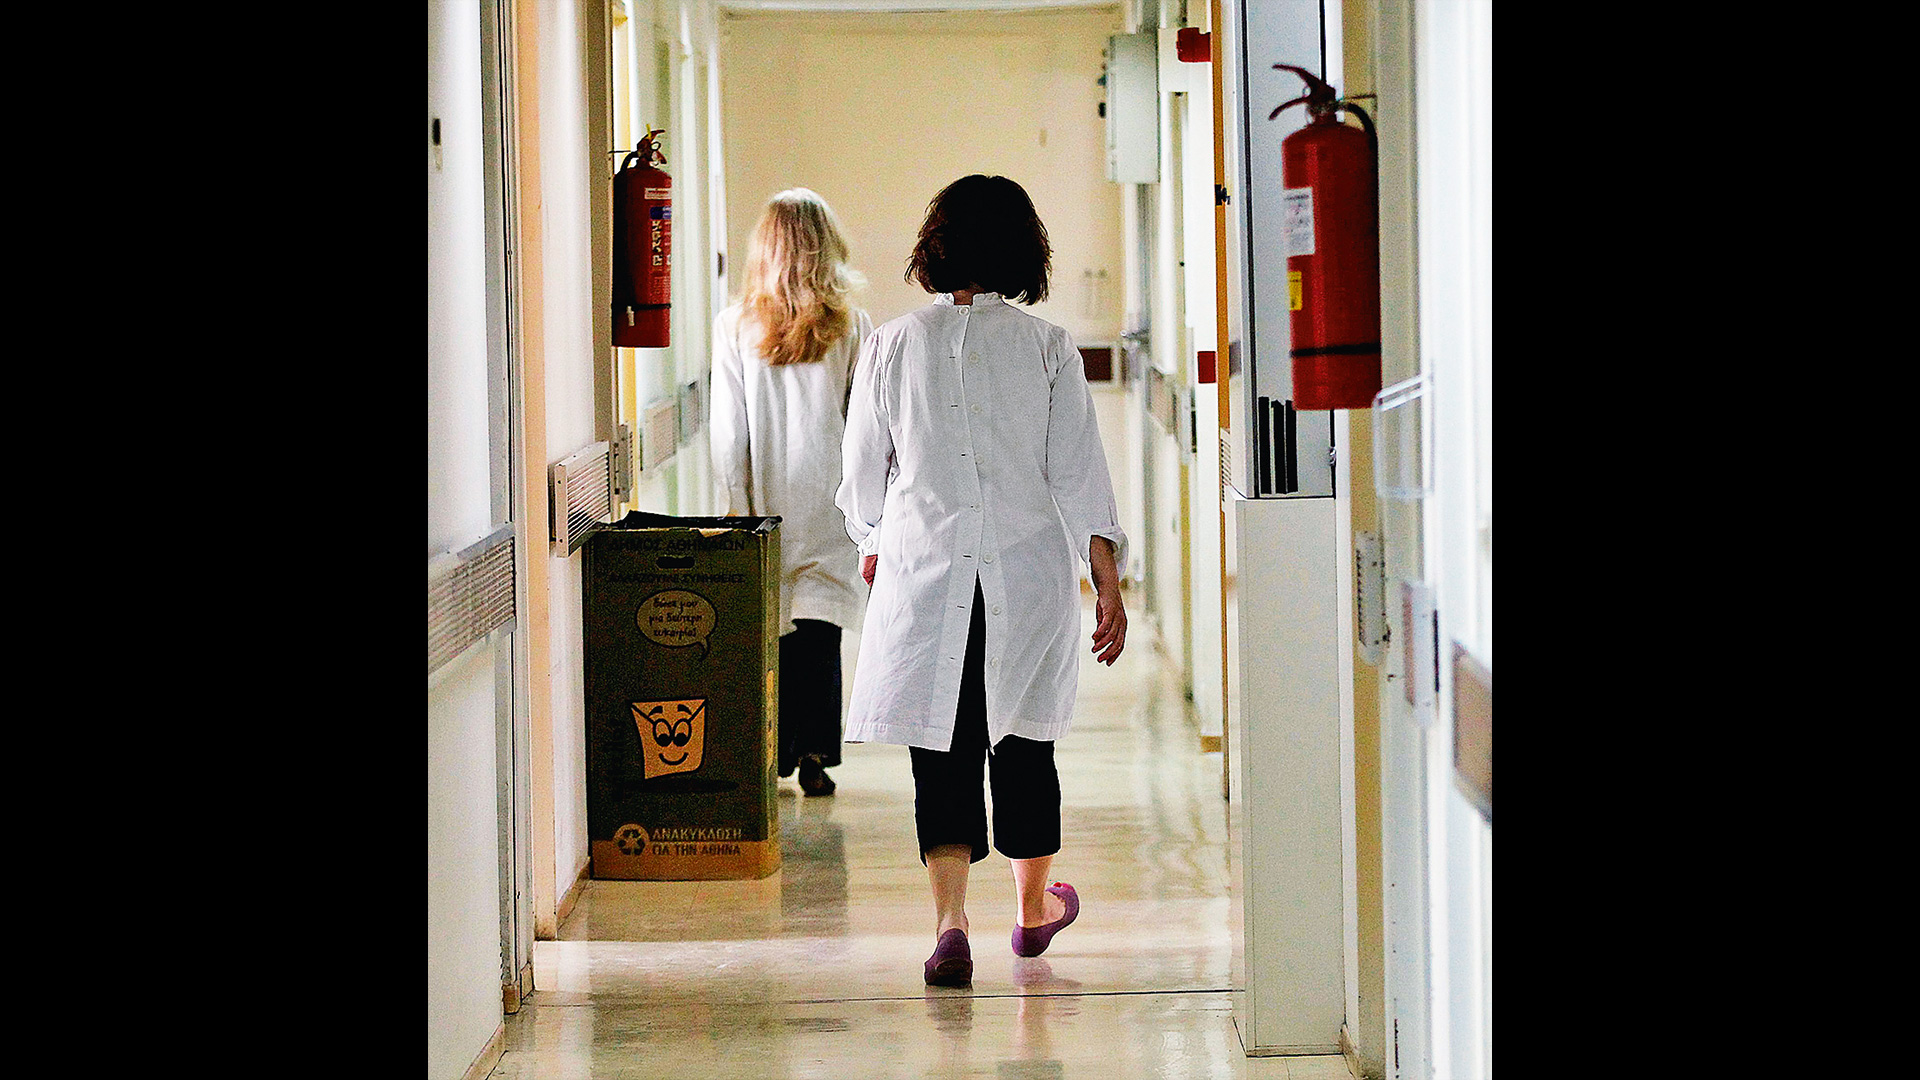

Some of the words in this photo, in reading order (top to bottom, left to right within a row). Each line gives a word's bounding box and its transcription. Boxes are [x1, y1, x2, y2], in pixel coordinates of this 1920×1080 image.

[652, 828, 742, 841] ΑΝΑΚΥΚΛΩΣΗ
[652, 844, 669, 856] ΓΙΑ
[675, 844, 698, 856] ΤΗΝ
[701, 844, 742, 856] ΑΘΗΝΑ
